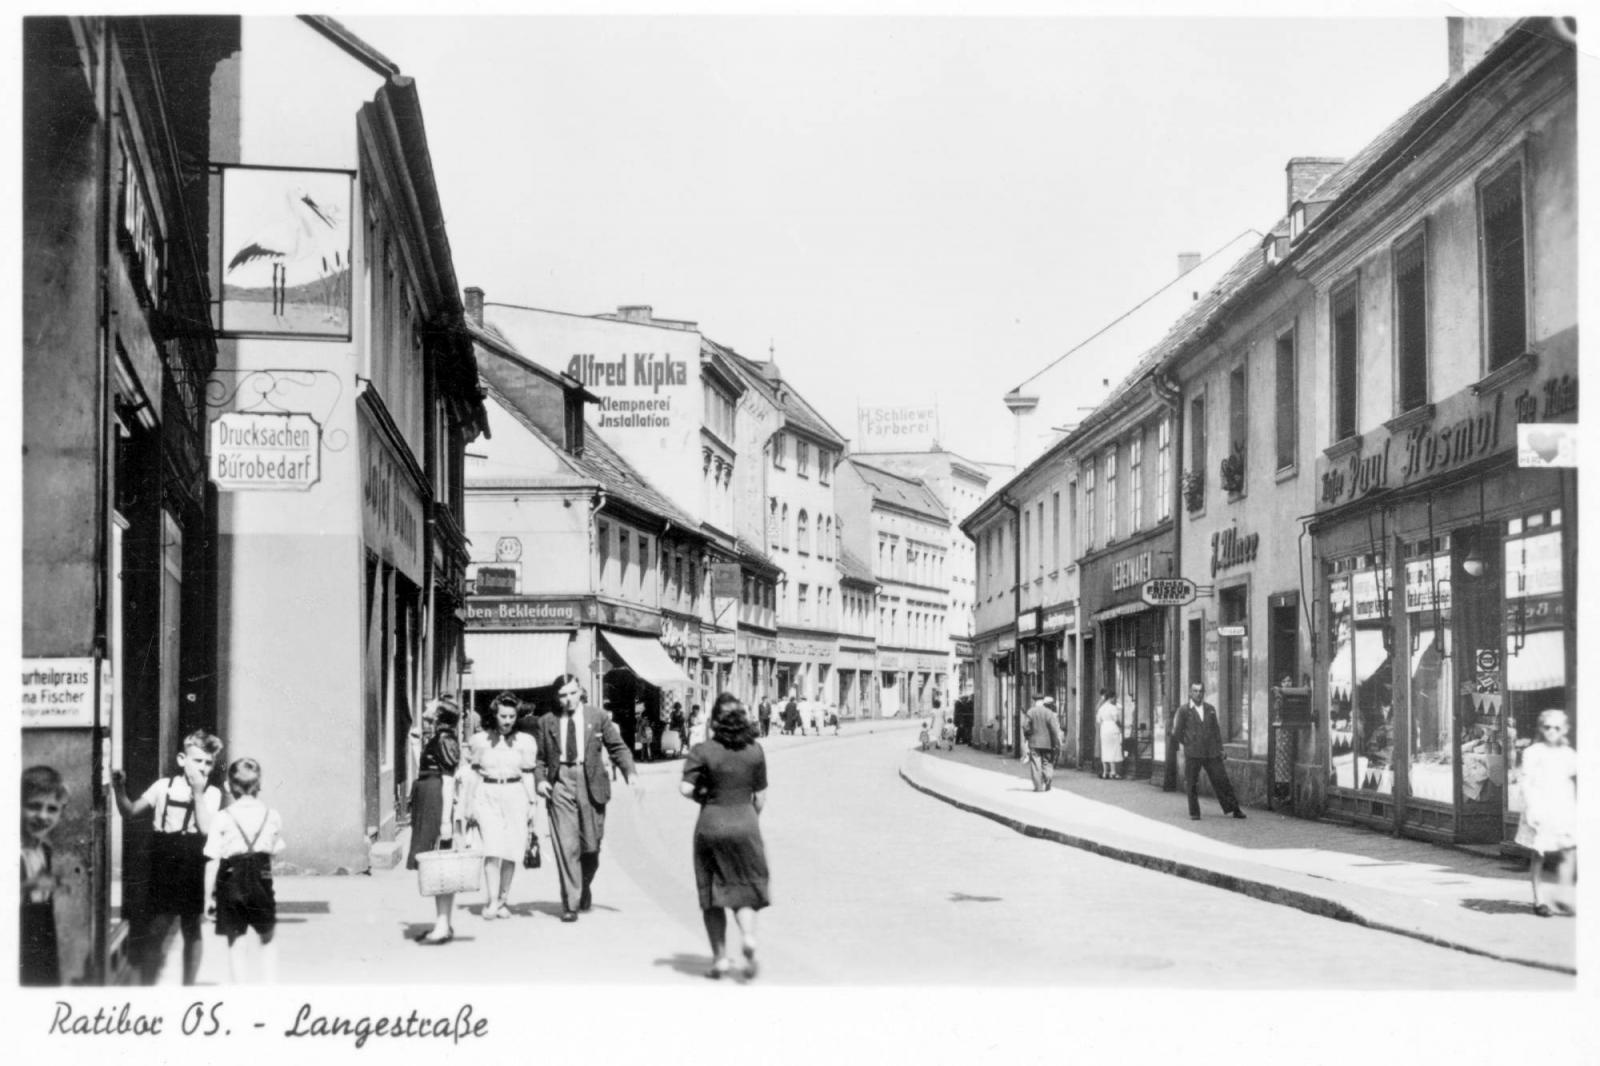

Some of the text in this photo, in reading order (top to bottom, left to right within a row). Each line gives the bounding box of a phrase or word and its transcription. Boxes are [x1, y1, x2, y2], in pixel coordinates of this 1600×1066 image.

[567, 353, 687, 394] Alfred Kipka
[598, 396, 671, 412] Klempnerei
[219, 420, 310, 447] Drucksachen
[218, 453, 311, 480] Bürobedarf
[1348, 436, 1391, 499] Paul
[40, 688, 85, 704] Fischer
